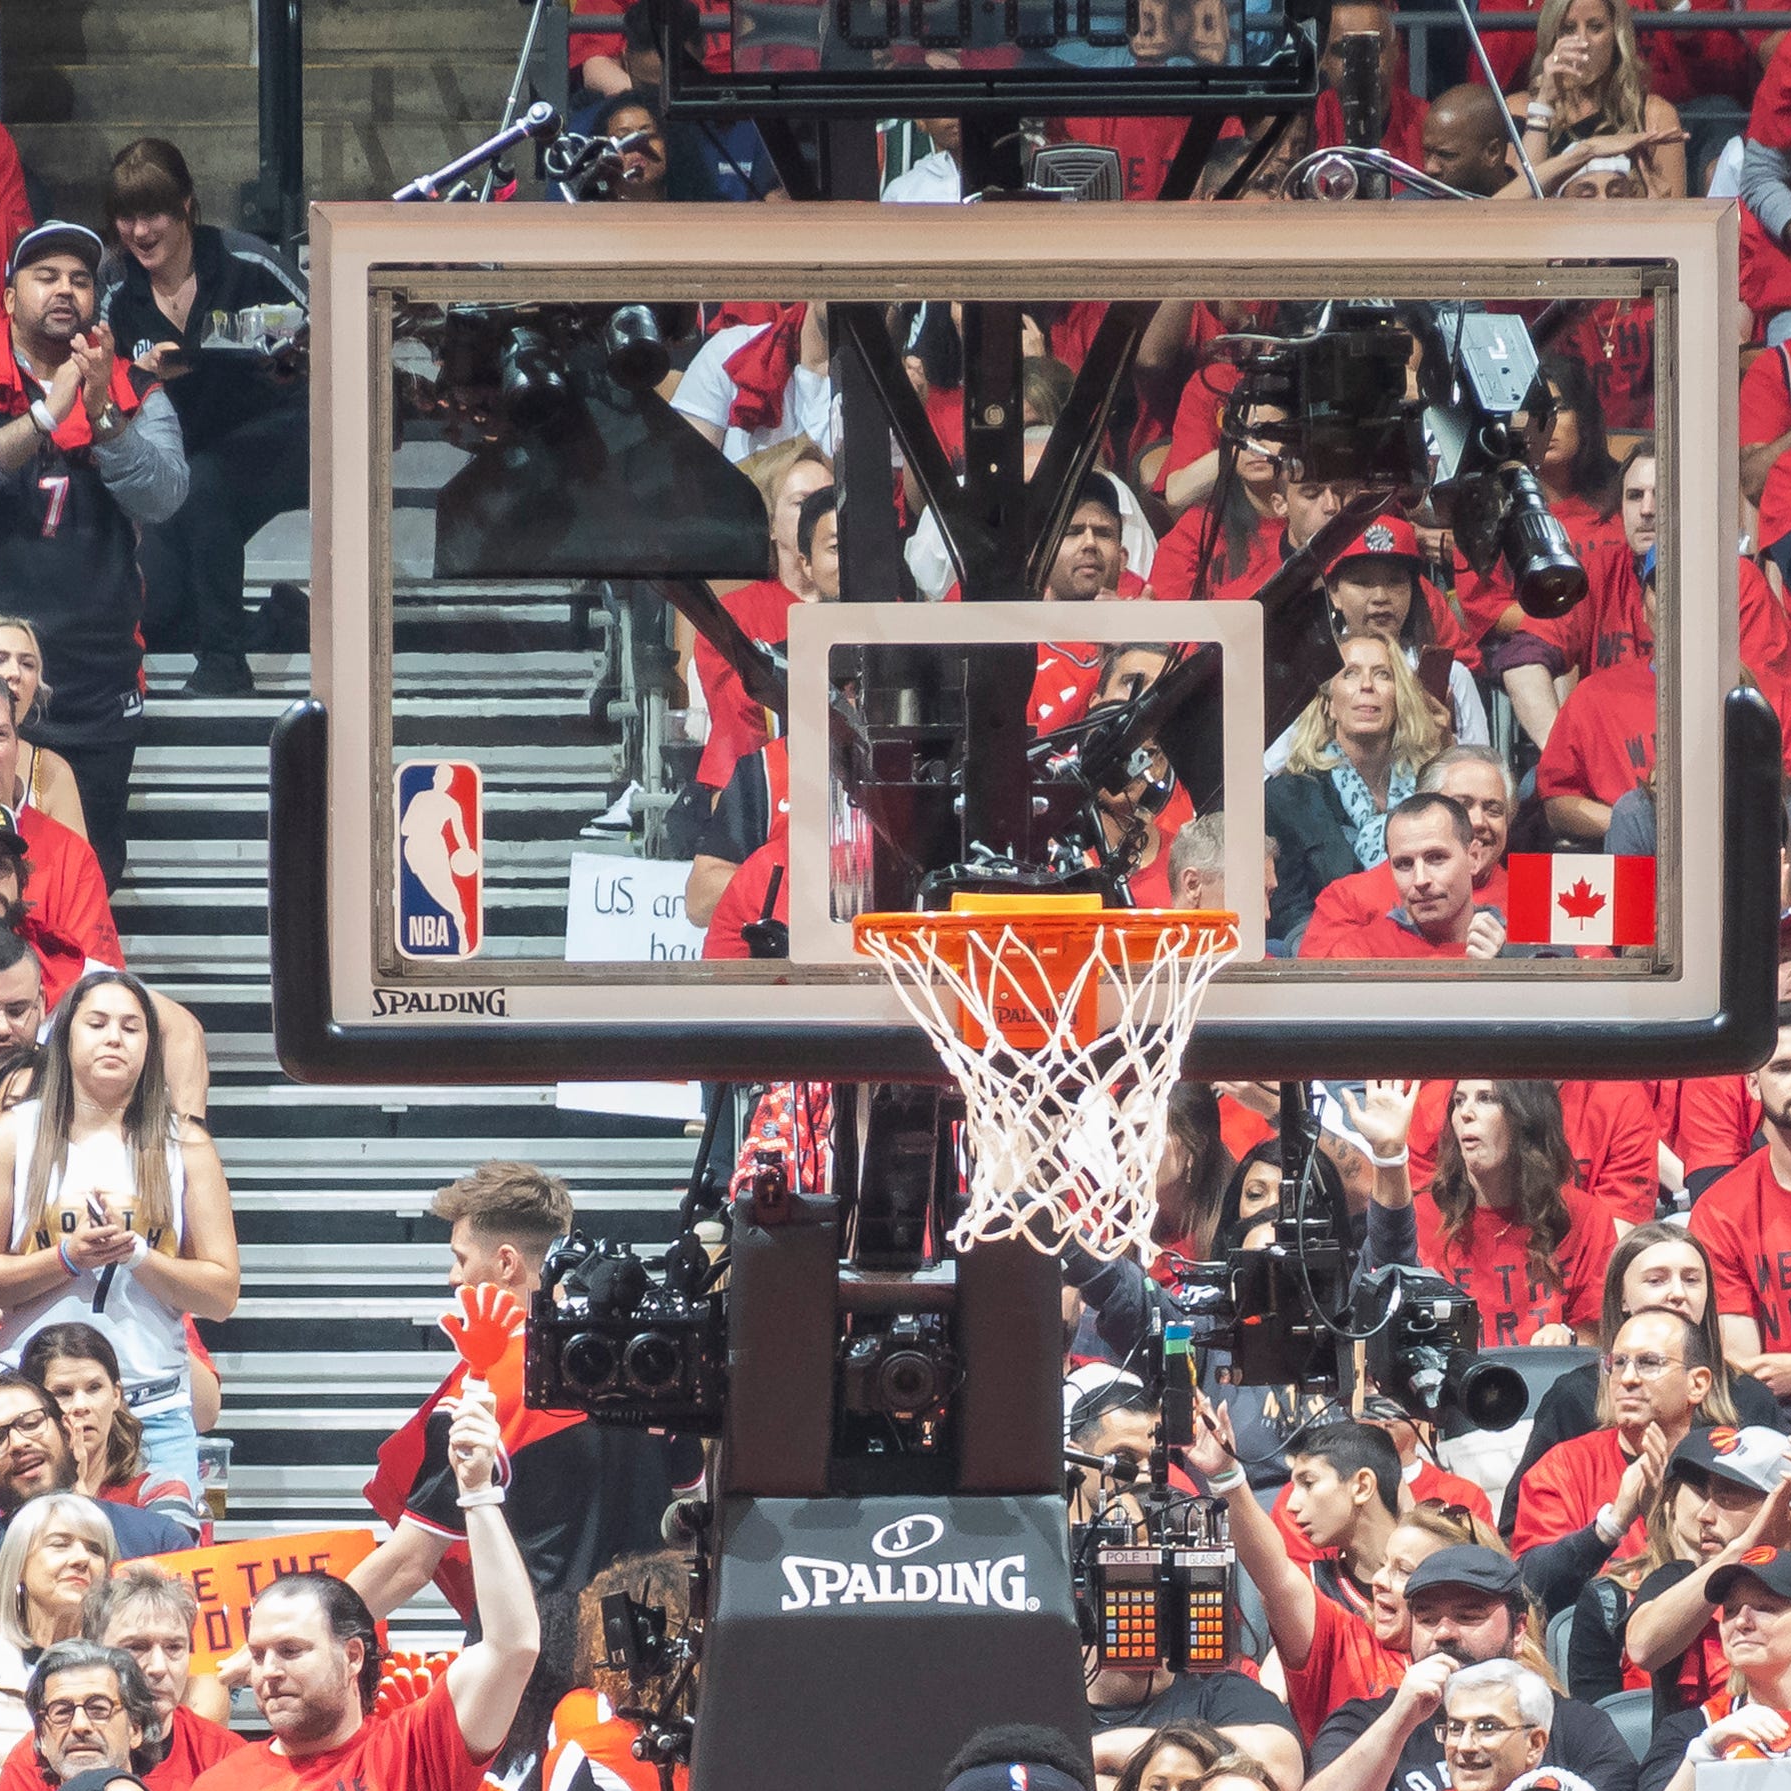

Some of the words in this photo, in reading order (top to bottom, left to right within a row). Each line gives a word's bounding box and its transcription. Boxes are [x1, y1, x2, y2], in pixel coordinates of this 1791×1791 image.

[38, 476, 69, 539] 7
[409, 915, 449, 948] NBA
[372, 987, 507, 1018] SPALDING
[35, 1210, 163, 1251] NOTH
[1105, 1552, 1140, 1565] POLE
[1188, 1553, 1217, 1566] GLASS
[782, 1555, 1029, 1612] SPALDING
